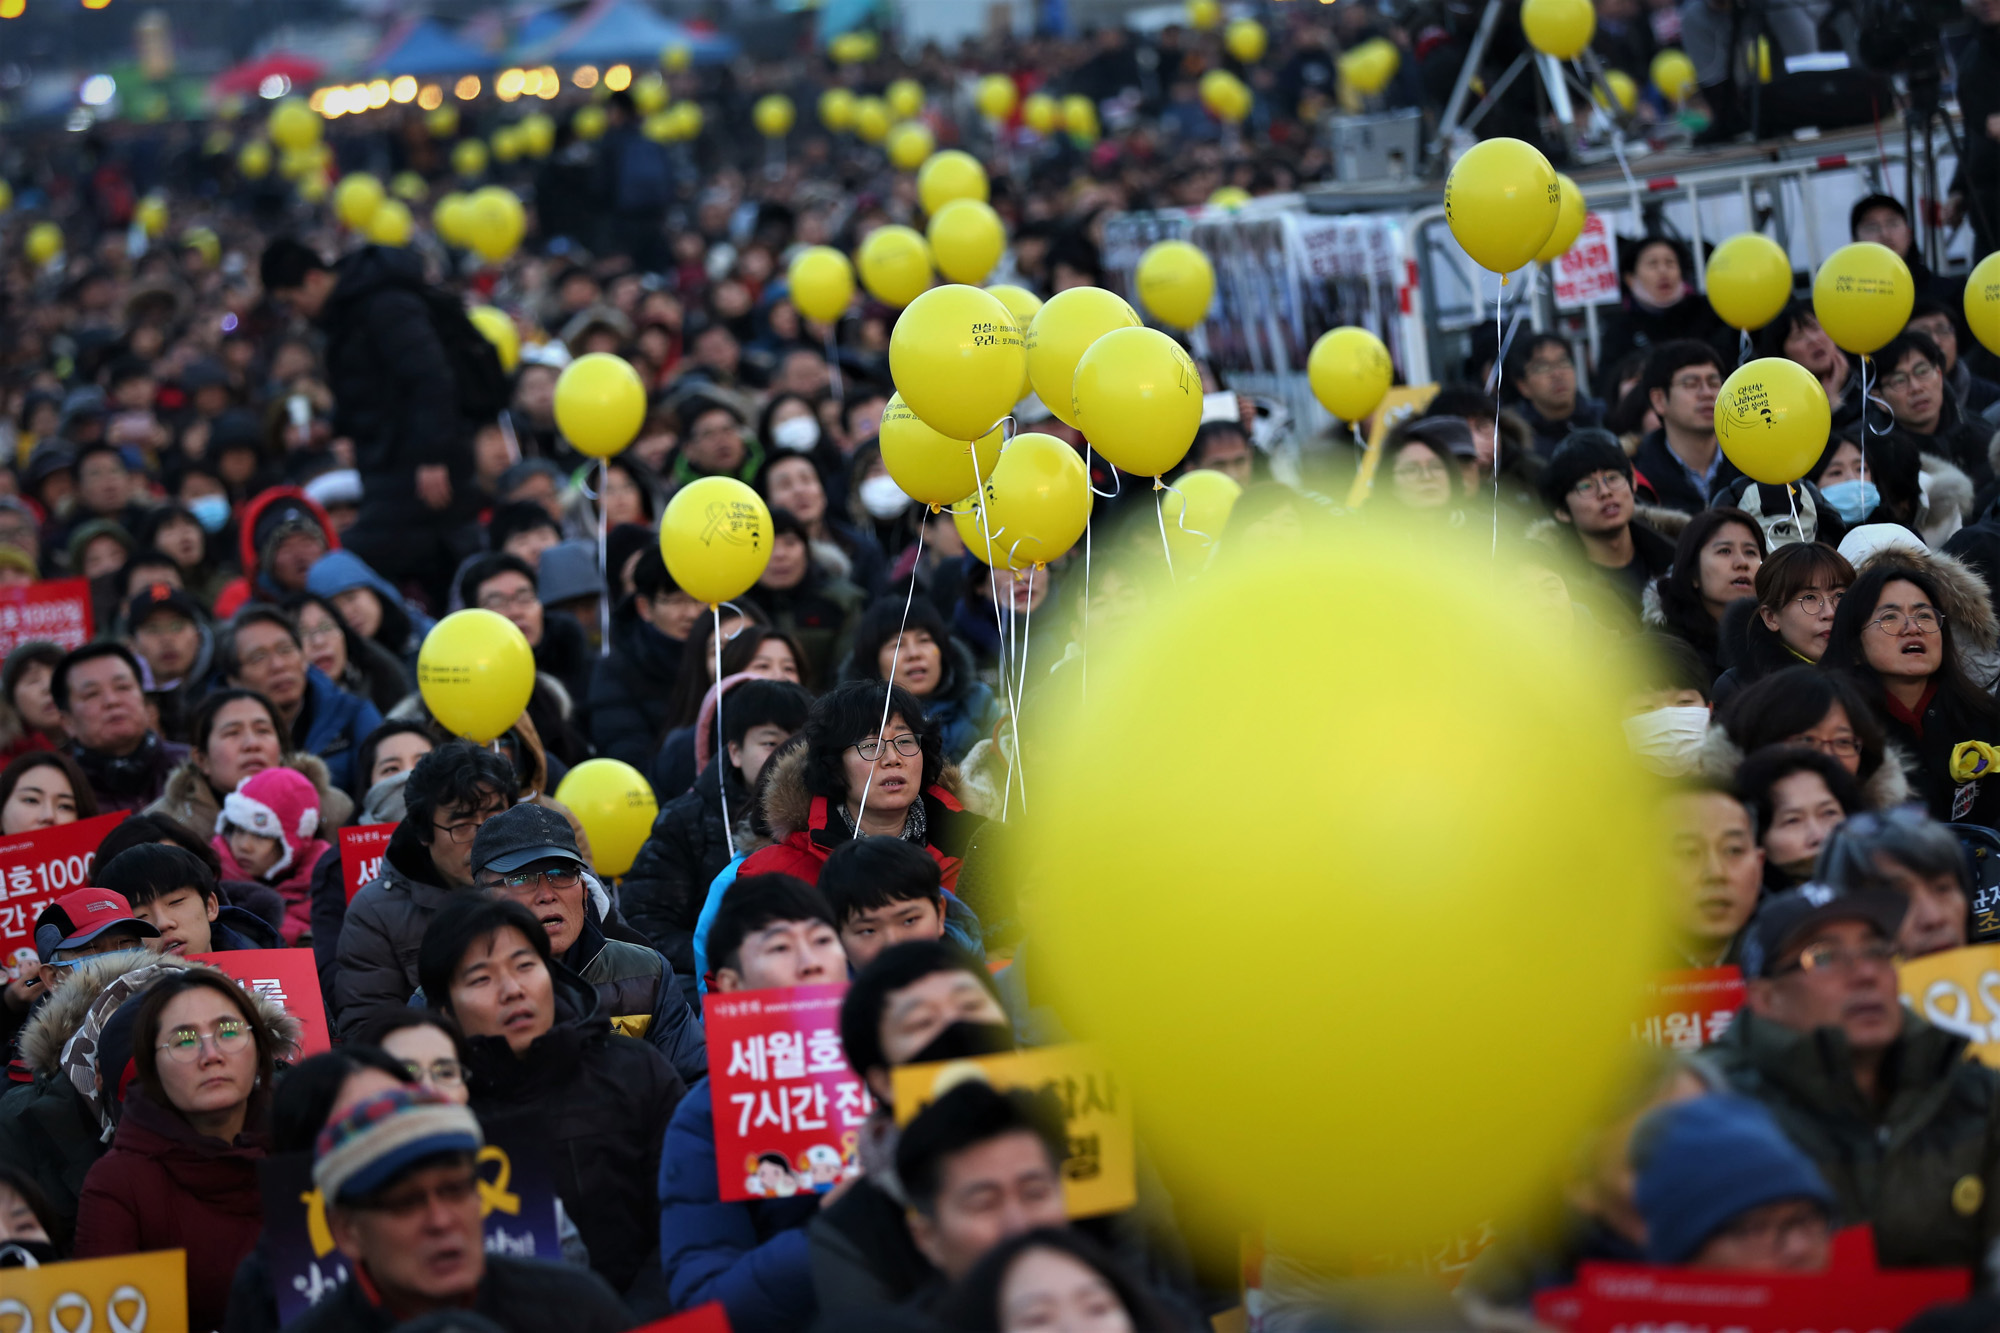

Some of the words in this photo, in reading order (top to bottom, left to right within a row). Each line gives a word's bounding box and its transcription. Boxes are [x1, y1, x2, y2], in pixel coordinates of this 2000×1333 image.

[972, 323, 998, 334] 진실은
[973, 335, 1001, 346] 우리는
[357, 856, 384, 886] 세
[727, 1028, 848, 1081] 세월호
[730, 1082, 829, 1137] 7시간
